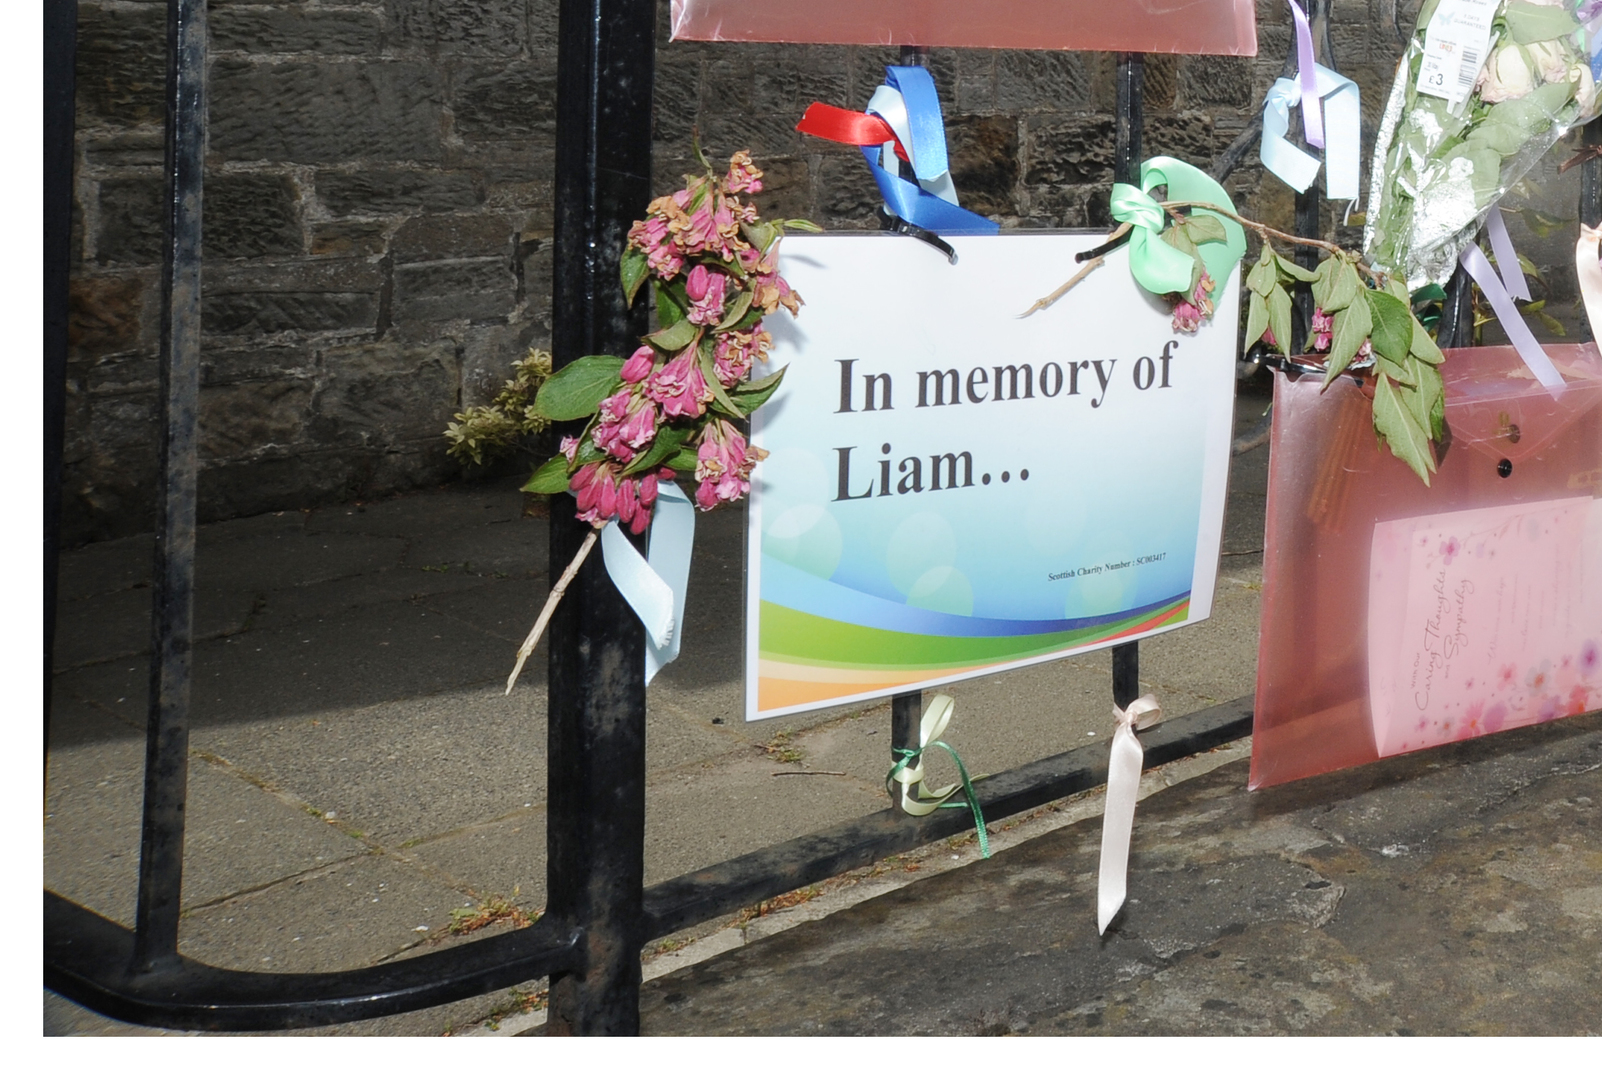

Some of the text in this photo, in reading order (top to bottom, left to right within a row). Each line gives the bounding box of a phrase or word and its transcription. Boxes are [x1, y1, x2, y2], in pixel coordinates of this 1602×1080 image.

[832, 339, 1180, 415] In memory of
[830, 442, 1030, 503] Liam...
[1048, 569, 1076, 582] Scottish
[1076, 565, 1103, 577] Charity
[1104, 560, 1132, 572] Number
[1415, 569, 1451, 711] Caring Thoughts
[1443, 579, 1475, 660] Sympathy
